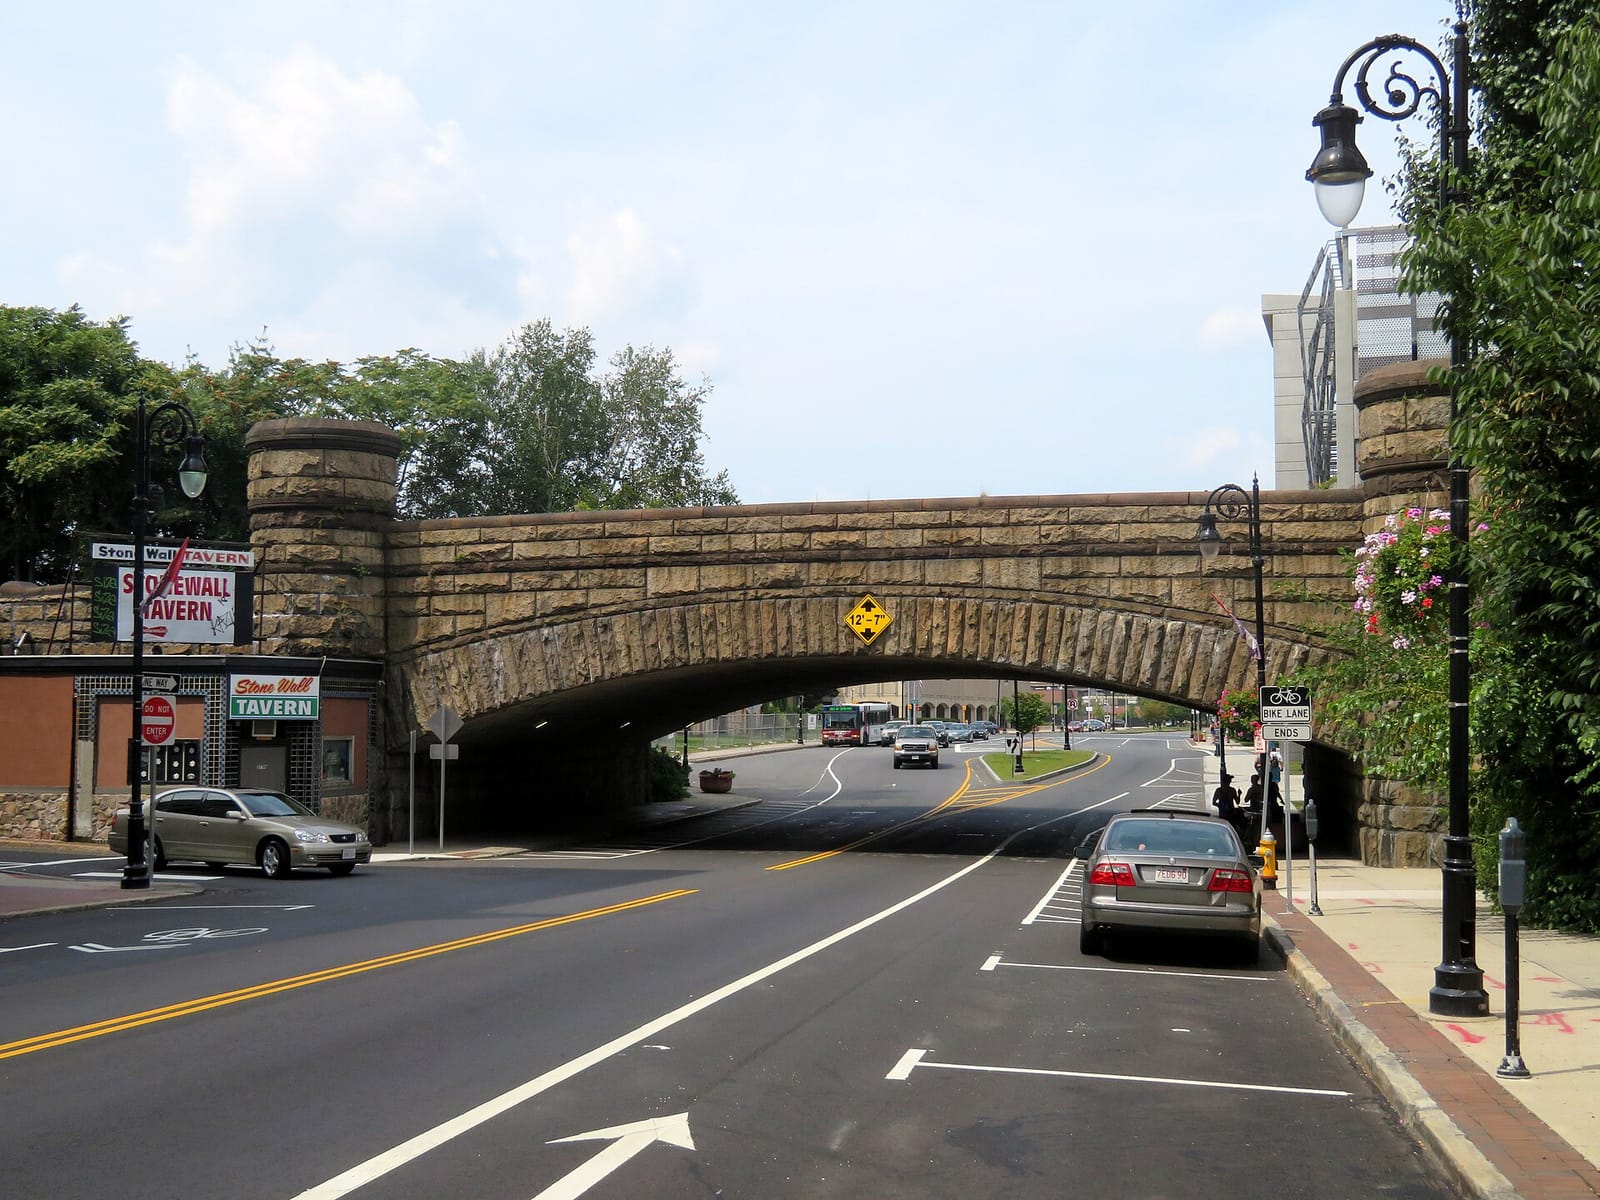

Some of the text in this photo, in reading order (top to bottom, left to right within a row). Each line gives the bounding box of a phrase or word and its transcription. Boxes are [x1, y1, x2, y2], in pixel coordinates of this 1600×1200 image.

[99, 546, 136, 559] Ston
[184, 551, 250, 564] TAVERN
[123, 573, 231, 597] SOEWALL
[142, 678, 169, 688] NE WAY
[235, 676, 314, 695] Stone Wall
[144, 705, 170, 713] DO NOT
[236, 699, 312, 715] TAVERN
[1263, 709, 1309, 718] BIKE LANE
[146, 727, 167, 736] ENTER
[1274, 728, 1299, 737] ENDS
